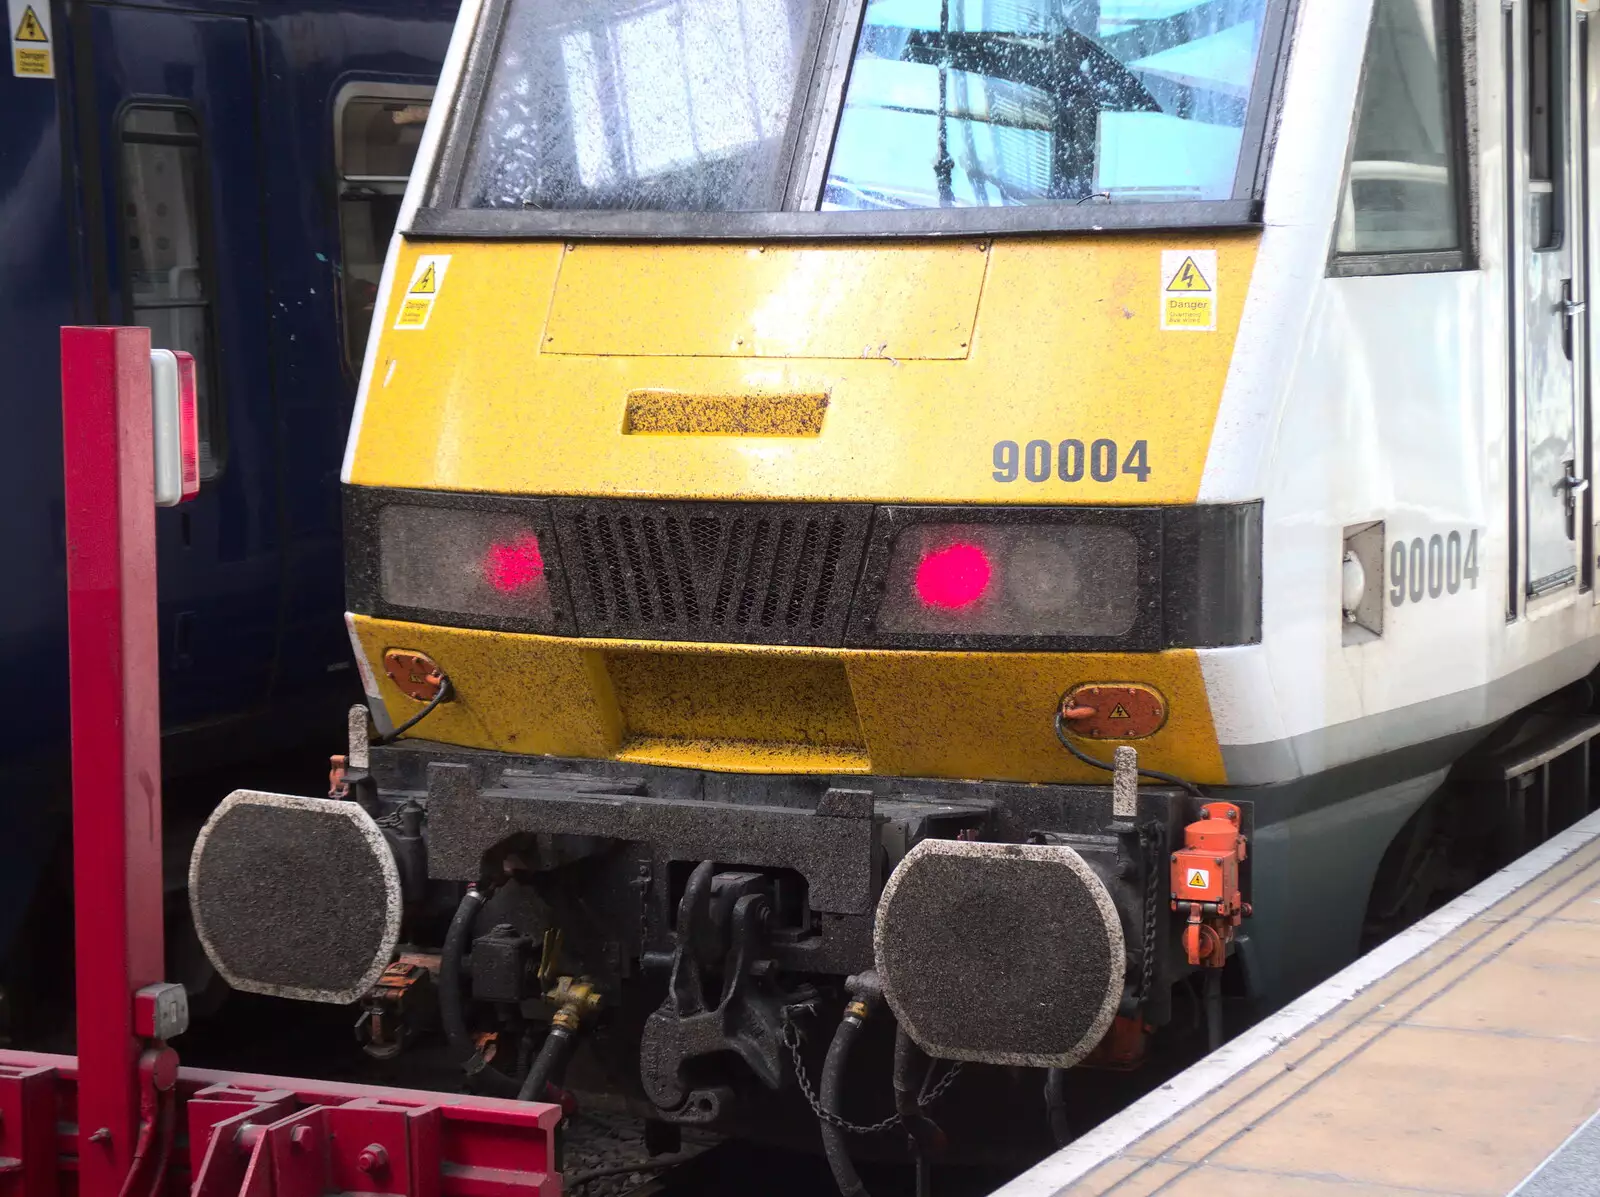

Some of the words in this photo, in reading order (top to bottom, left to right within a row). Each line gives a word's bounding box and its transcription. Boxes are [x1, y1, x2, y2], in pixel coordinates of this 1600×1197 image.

[1169, 300, 1208, 310] Danger
[992, 438, 1151, 482] 90004
[1390, 529, 1479, 607] 90004
